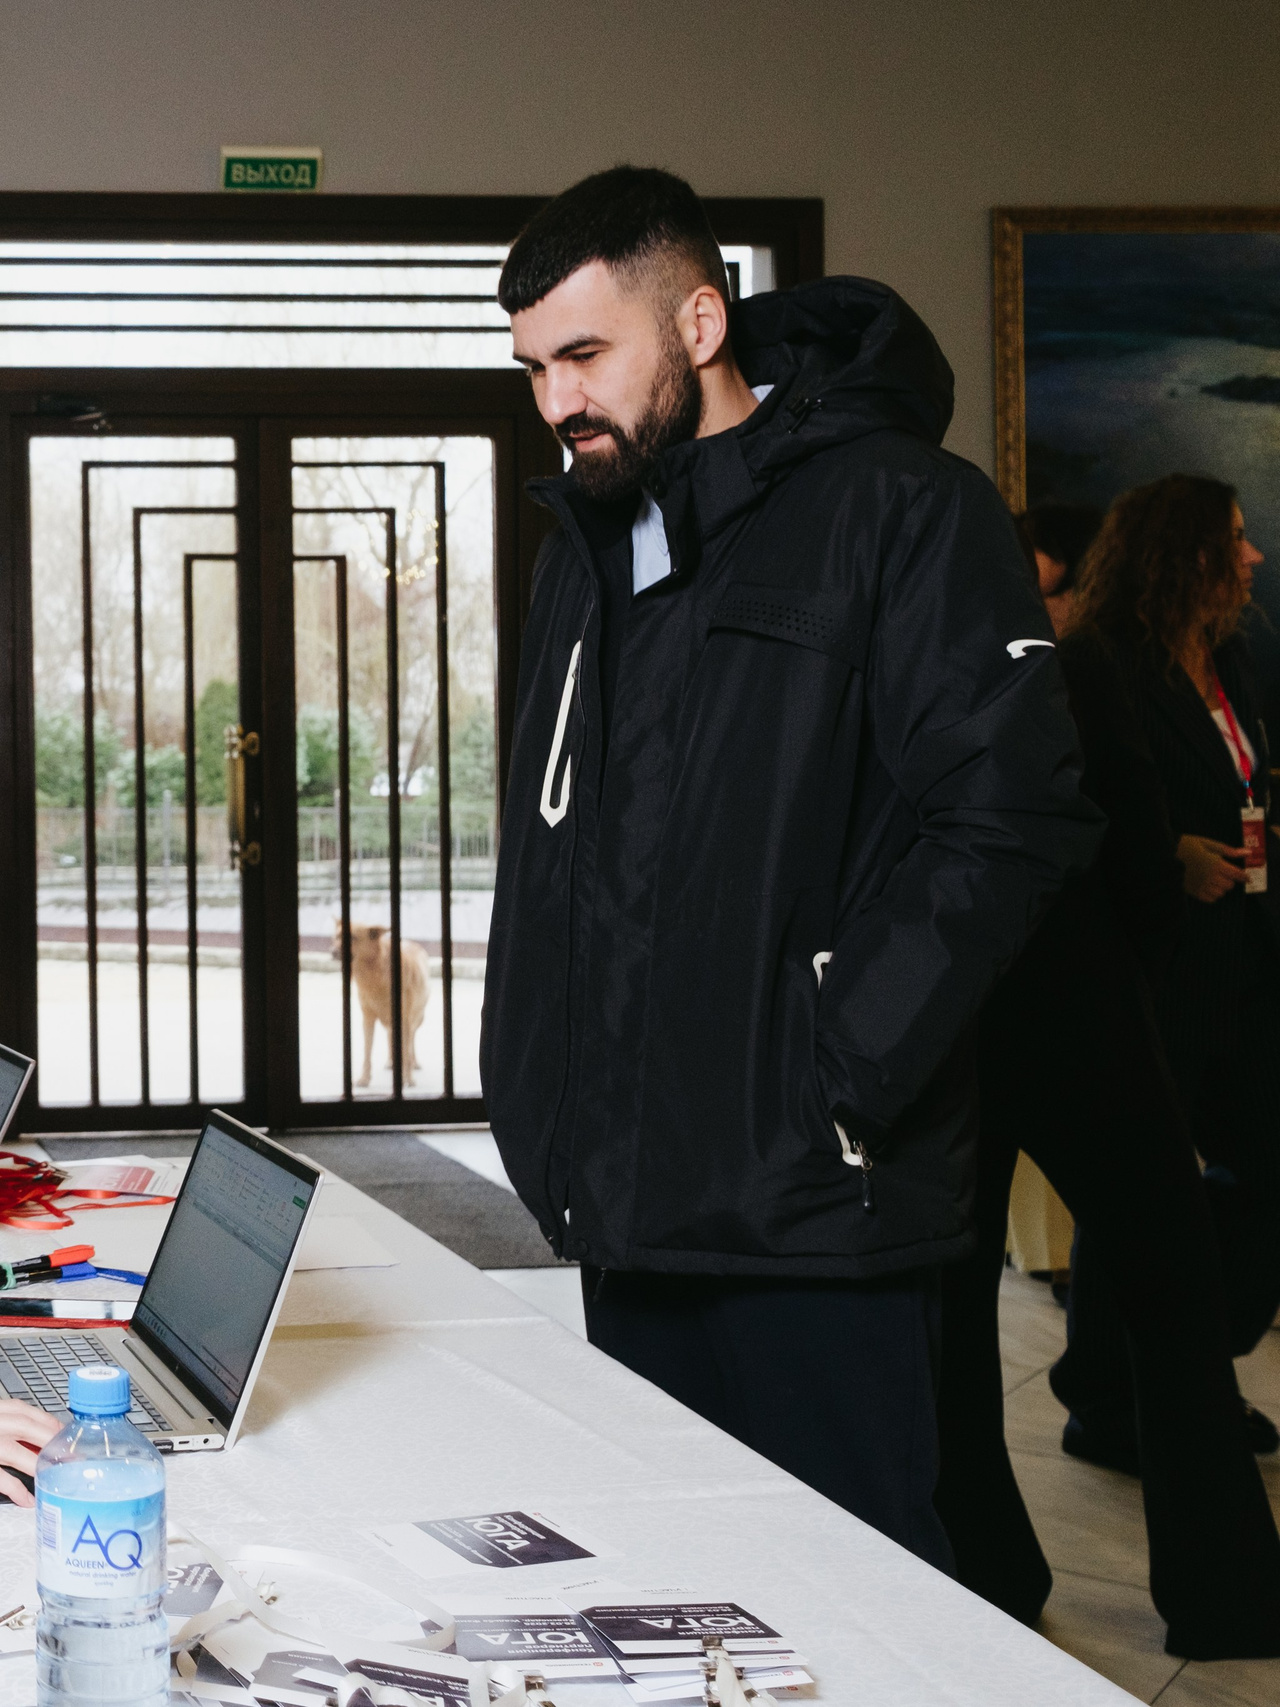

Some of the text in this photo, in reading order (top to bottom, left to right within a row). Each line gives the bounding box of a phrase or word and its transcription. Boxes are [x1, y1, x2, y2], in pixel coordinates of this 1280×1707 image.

[231, 163, 312, 187] ВЫХОД
[464, 1516, 531, 1551] ЮГА
[71, 1514, 143, 1571] AQ
[65, 1557, 105, 1569] AQUEEN
[92, 1571, 118, 1580] drinking
[640, 1616, 757, 1629] ЮГА
[476, 1631, 590, 1645] ЮГА
